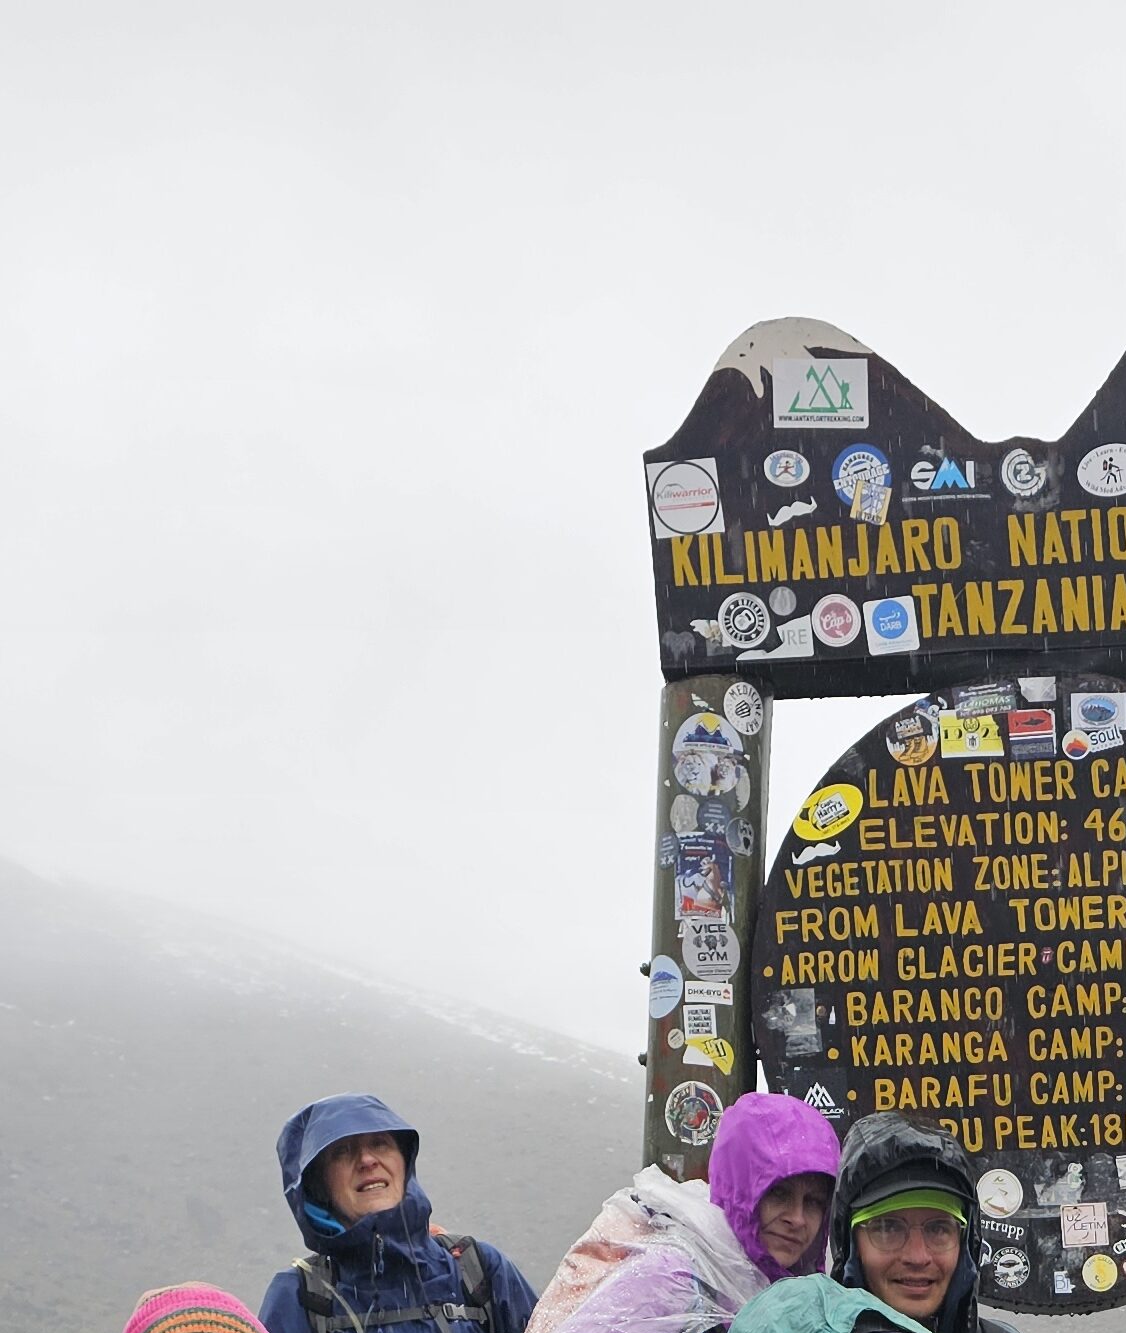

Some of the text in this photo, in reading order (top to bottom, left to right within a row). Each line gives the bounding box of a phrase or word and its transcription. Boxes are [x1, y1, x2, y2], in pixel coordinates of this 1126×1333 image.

[671, 517, 963, 587] KILIMANJARO
[729, 683, 762, 720] MEDICINE
[1089, 725, 1121, 746] soul
[868, 766, 950, 808] LAVA
[963, 760, 1076, 803] TOWER
[859, 811, 1068, 851] ELEVATION:
[784, 857, 953, 899] VEGETATION
[692, 924, 727, 934] VICE
[775, 904, 879, 944] FROM
[895, 900, 983, 937] LAVA
[696, 952, 728, 962] GYM
[781, 948, 879, 986] ARROW
[897, 942, 1038, 981] GLACIER
[846, 986, 1003, 1026] BARANCO
[851, 1030, 1008, 1067] KARANGA
[1028, 1026, 1124, 1062] CAMP:
[874, 1073, 1012, 1112] BARAFU
[1029, 1070, 1124, 1106] CAMP:
